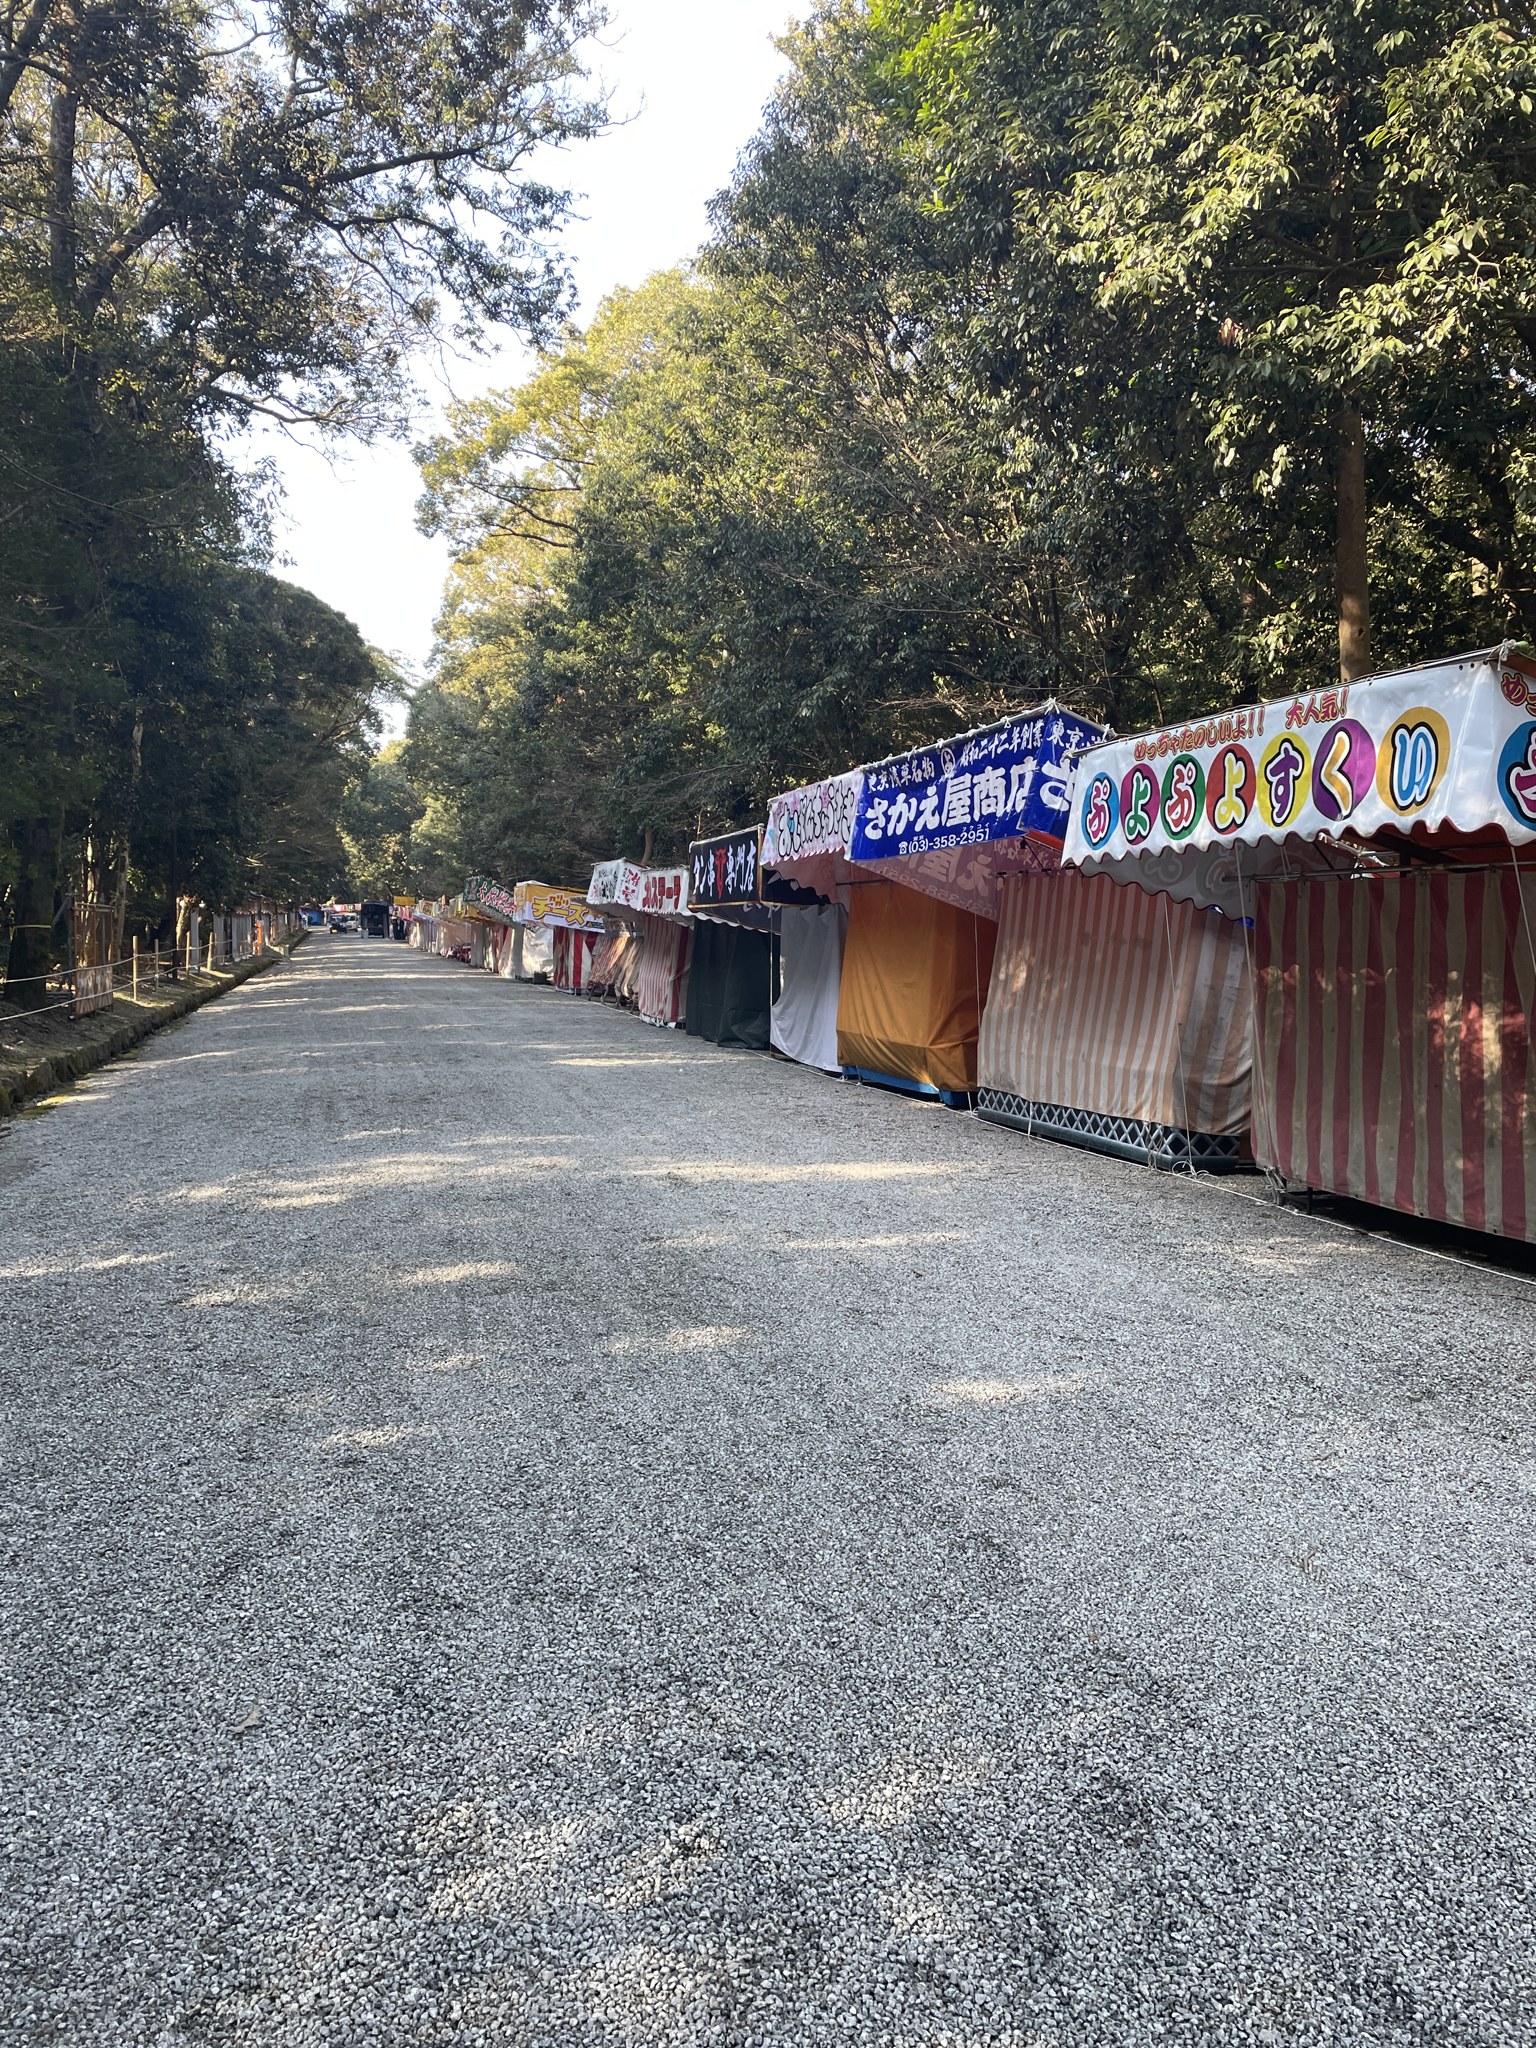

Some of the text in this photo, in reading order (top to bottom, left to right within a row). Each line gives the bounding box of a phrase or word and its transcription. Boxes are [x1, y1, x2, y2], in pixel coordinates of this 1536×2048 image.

[865, 756, 1038, 840] さかえ屋商店
[1085, 722, 1440, 846] ぷよぷよすくい
[531, 897, 588, 927] チーズ
